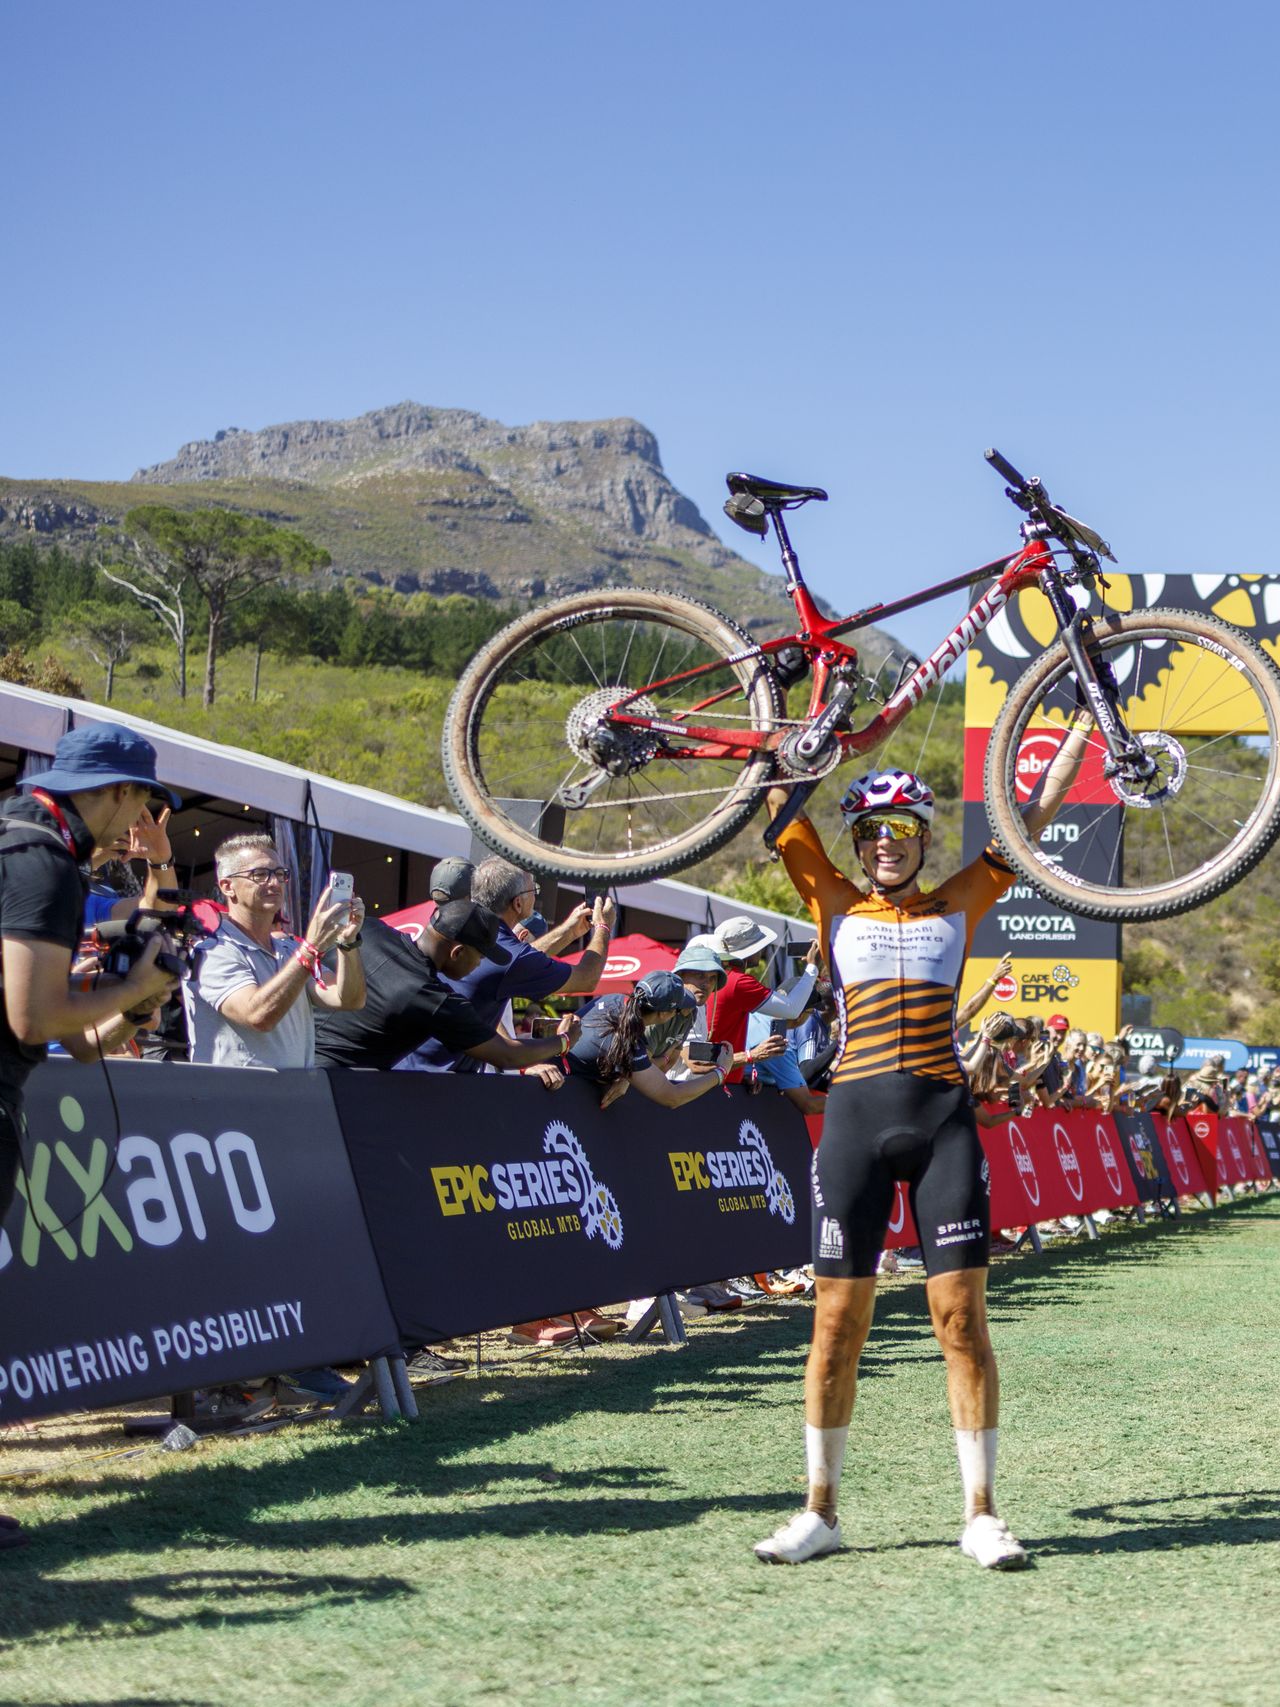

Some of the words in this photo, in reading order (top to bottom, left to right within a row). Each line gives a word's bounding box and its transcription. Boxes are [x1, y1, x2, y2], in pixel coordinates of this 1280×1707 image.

[1094, 701, 1115, 732] SWISS
[1049, 865, 1085, 887] SWISS
[998, 915, 1076, 932] TOYOTA
[1021, 974, 1050, 983] CAPE
[1021, 984, 1069, 1003] EPIC
[0, 1098, 275, 1269] xxaro
[668, 1152, 710, 1192] EPIC
[705, 1151, 766, 1189] SERIES
[431, 1165, 497, 1216] EPIC
[491, 1159, 581, 1210] SERIES
[718, 1195, 749, 1214] GLOBAL
[750, 1194, 766, 1209] MTB
[508, 1217, 555, 1241] GLOBAL
[559, 1215, 582, 1234] MTB
[937, 1219, 980, 1235] SPIER
[152, 1301, 305, 1367] POSSIBILITY
